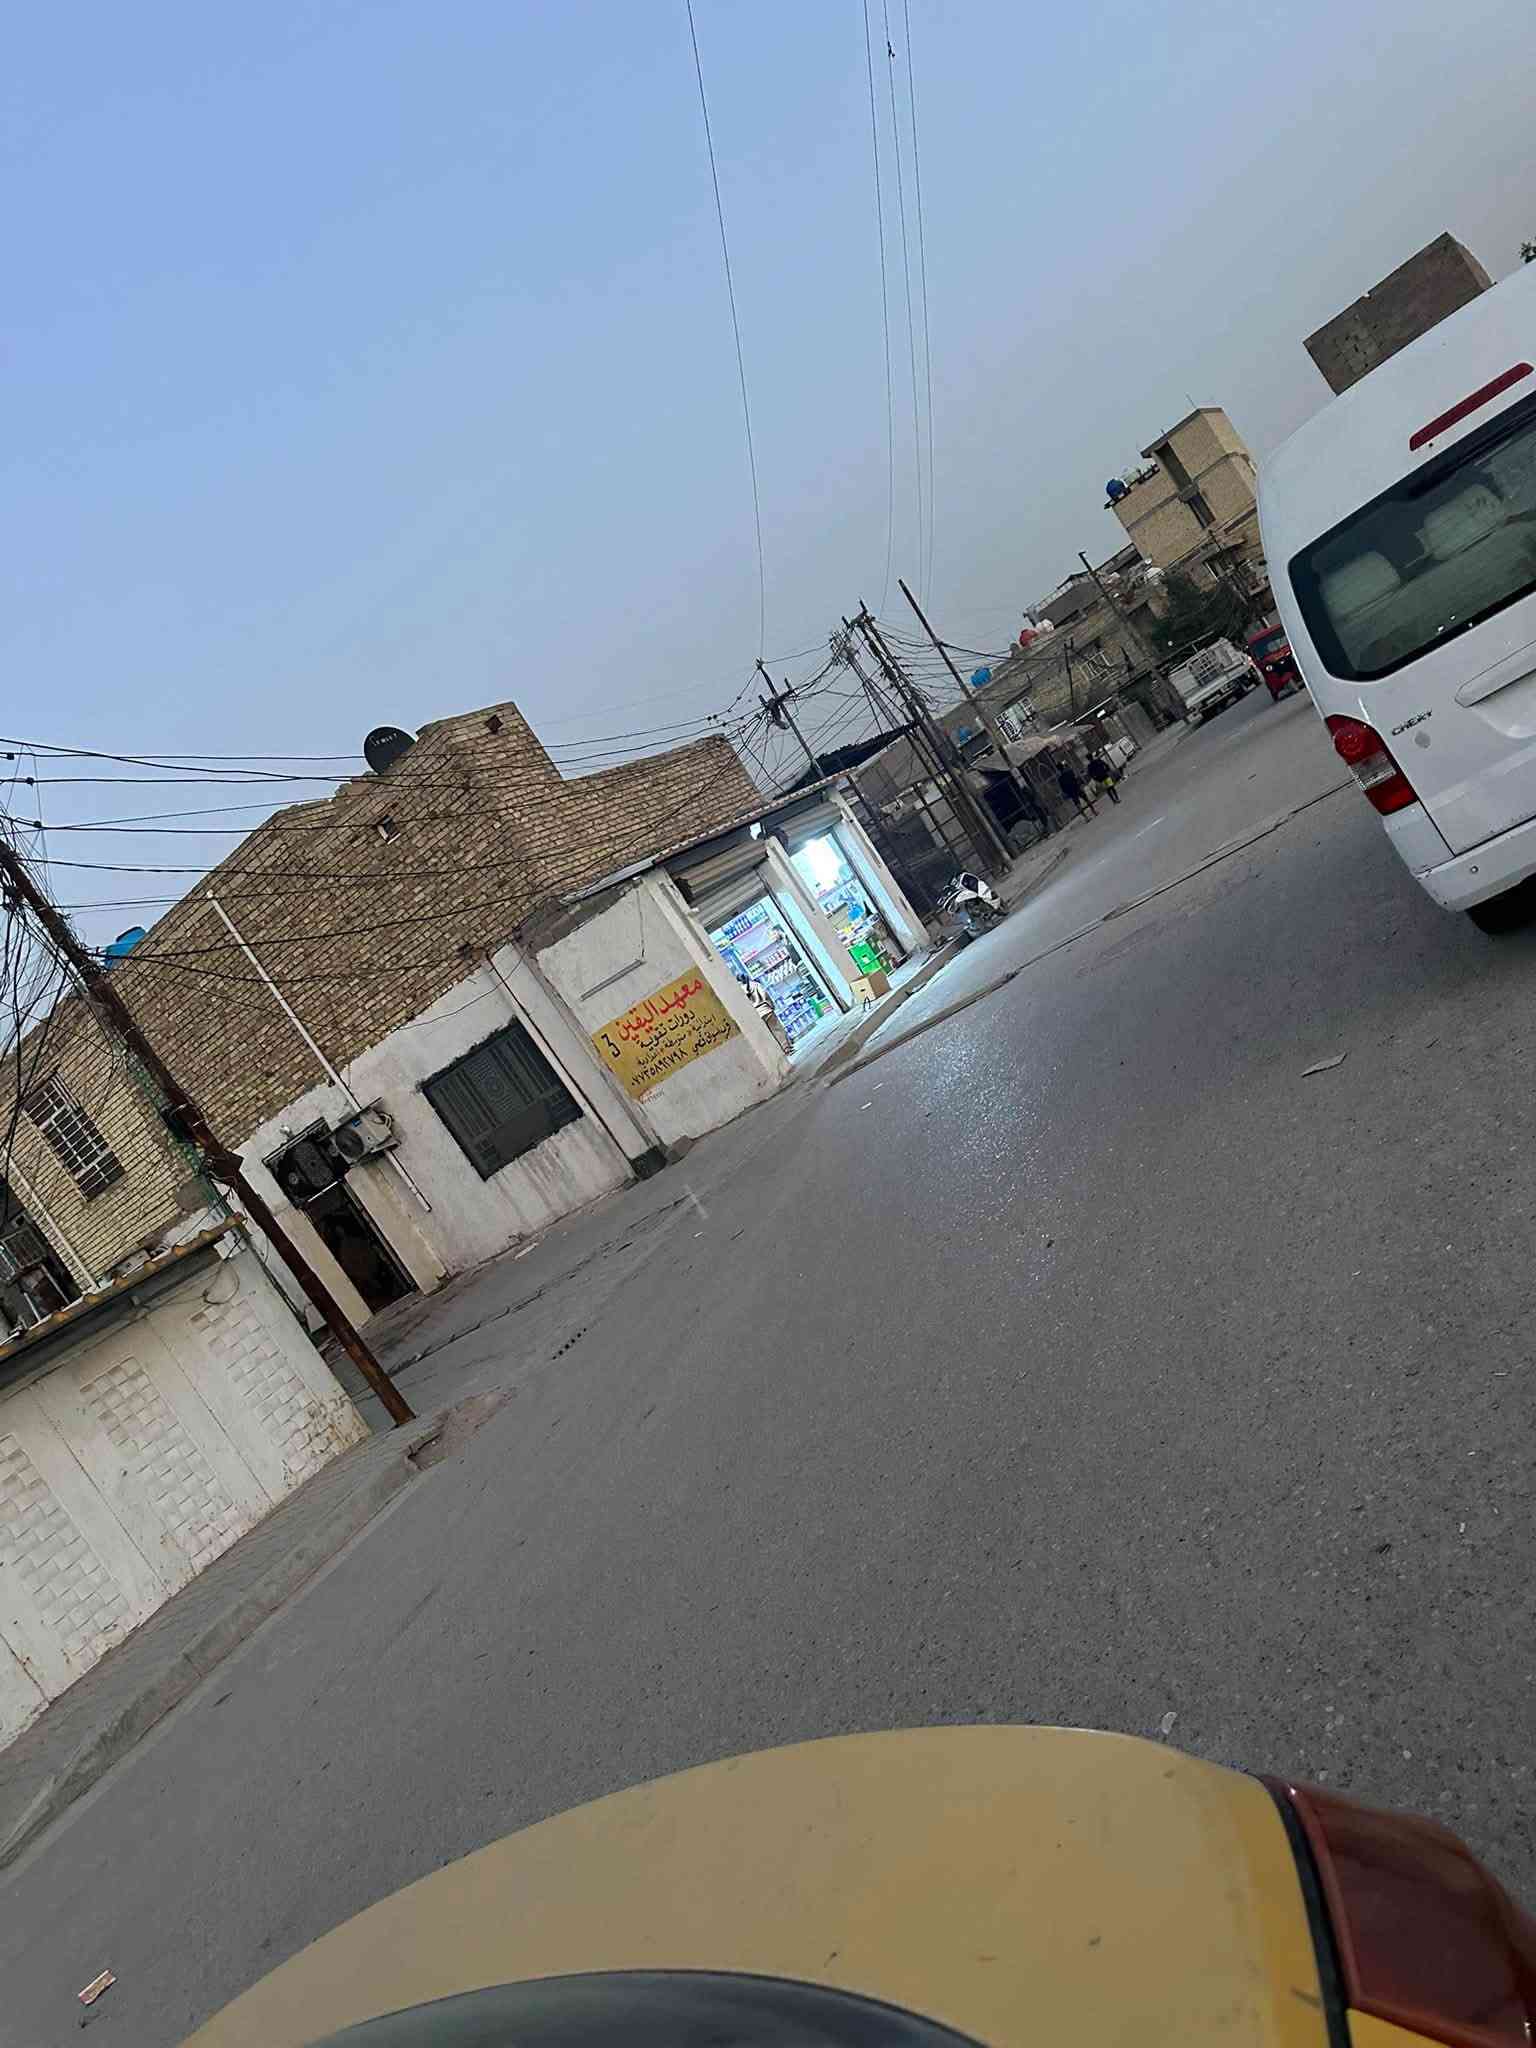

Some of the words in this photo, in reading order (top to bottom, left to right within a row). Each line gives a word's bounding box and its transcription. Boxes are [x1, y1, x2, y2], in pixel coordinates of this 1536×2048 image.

[658, 978, 704, 1015] معهد
[616, 999, 660, 1041] اليقين
[669, 1009, 695, 1031] دورات
[636, 1023, 668, 1051] تقوية
